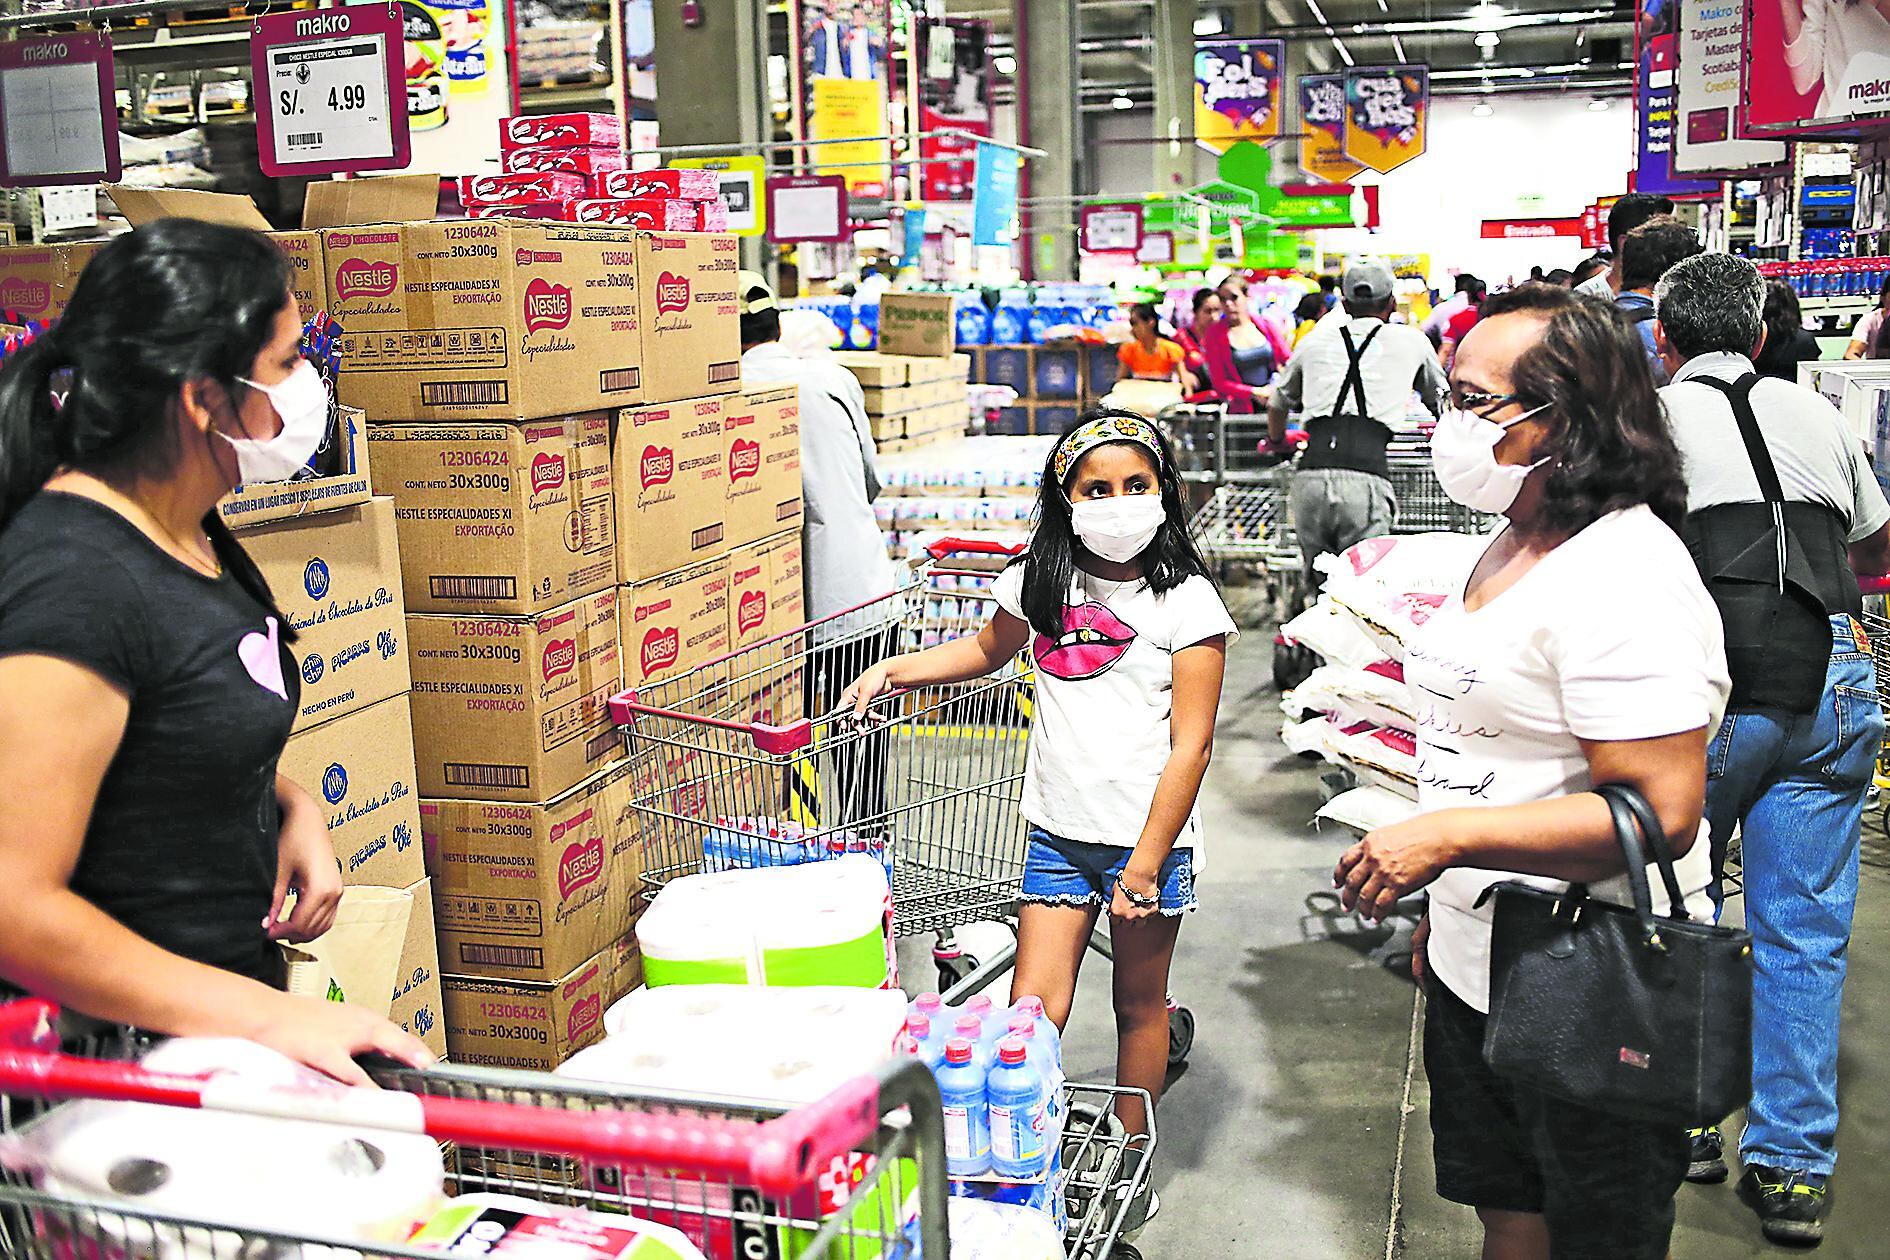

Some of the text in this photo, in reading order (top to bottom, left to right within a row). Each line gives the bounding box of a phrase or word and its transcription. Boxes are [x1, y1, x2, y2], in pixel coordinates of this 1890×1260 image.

[1700, 7, 1733, 20] Makro
[296, 13, 351, 37] makro
[1690, 26, 1728, 42] Tarjetas
[23, 42, 68, 62] makro
[280, 84, 366, 116] S/. 4.99
[443, 225, 498, 241] 12306424
[1503, 223, 1556, 237] Entrada
[353, 233, 398, 245] CHOCOLATE
[450, 245, 498, 259] 30x300g
[601, 251, 634, 267] 12306424
[342, 268, 392, 288] Nestlé
[404, 278, 501, 294] NESTLE ESPECIALIDADES XI
[606, 273, 635, 290] 30x300g
[303, 290, 313, 300] XI
[452, 292, 502, 305] EXPORTAÇÃO
[659, 283, 687, 301] Nestlé
[331, 300, 402, 322] Especialidades
[528, 293, 569, 317] Nestlé
[581, 305, 598, 318] NESTLE
[597, 304, 631, 317] ESPECIALIDADES
[521, 334, 576, 363] Especialidades
[439, 450, 510, 467] 12306424
[643, 456, 672, 475] Nestlé
[732, 448, 758, 467] Nestlé
[533, 460, 565, 481] Nestlé
[405, 473, 511, 492] CONT. NETO 30x300g
[395, 508, 513, 520] NESTLE ESPECIALIDADES XI
[454, 522, 515, 540] EXPORTAÇÃO
[316, 609, 326, 624] de
[328, 600, 364, 621] Chocolates
[364, 596, 374, 610] de
[374, 587, 393, 608] Perú
[451, 620, 521, 637] 12306424
[417, 644, 521, 664] CONT. NETO 30x300g
[545, 643, 574, 669] Nestlé
[643, 634, 677, 661] Nestlé
[440, 682, 512, 695] ESPECIALIDADES
[513, 683, 524, 696] XI
[302, 688, 355, 717] HECHO EN PERÚ
[466, 698, 526, 714] EXPORTAÇÃO
[345, 797, 380, 823] Chocolates
[481, 806, 533, 821] 12306424
[471, 827, 487, 835] NETO
[487, 823, 533, 839] 30x300g
[442, 853, 535, 866] NESTLE ESPECIALIDADES XI
[562, 845, 601, 882] Nestlé
[489, 867, 537, 880] EXPORTAÇÃO
[479, 1003, 548, 1021] 12306424
[467, 1027, 488, 1037] NETO
[488, 1024, 548, 1044] 30x300g
[469, 1055, 549, 1069] ESPECIALIDADES XI
